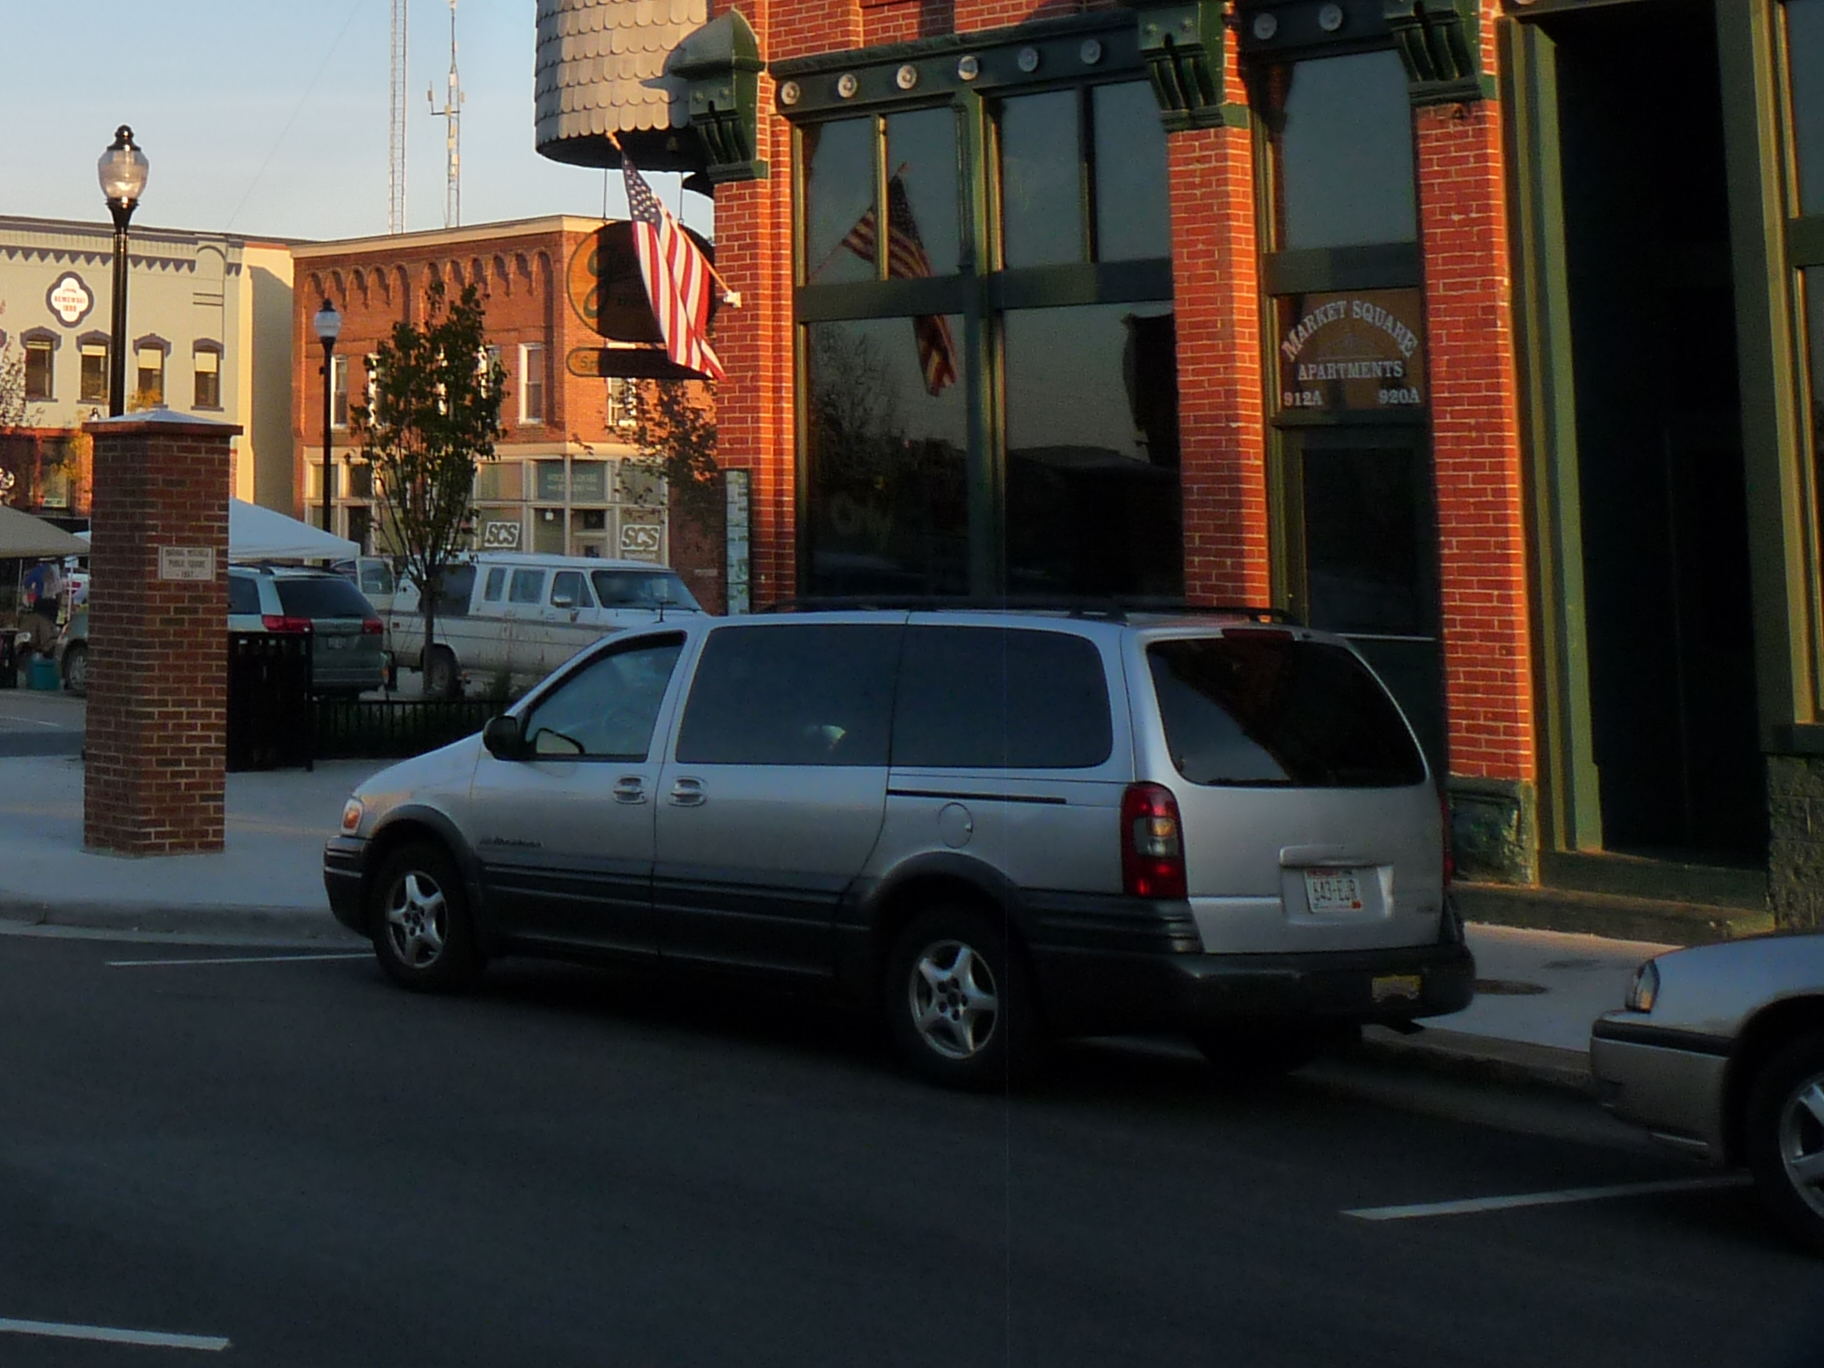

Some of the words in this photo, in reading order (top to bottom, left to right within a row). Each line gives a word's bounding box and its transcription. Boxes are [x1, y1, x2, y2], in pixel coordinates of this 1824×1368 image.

[1281, 300, 1347, 363] MARKET
[1352, 299, 1418, 359] SQUARE
[1297, 360, 1403, 381] APARTMENTS
[1283, 389, 1323, 406] 912A
[1379, 387, 1421, 404] 920A
[485, 523, 518, 545] SCS
[622, 526, 659, 548] SCS
